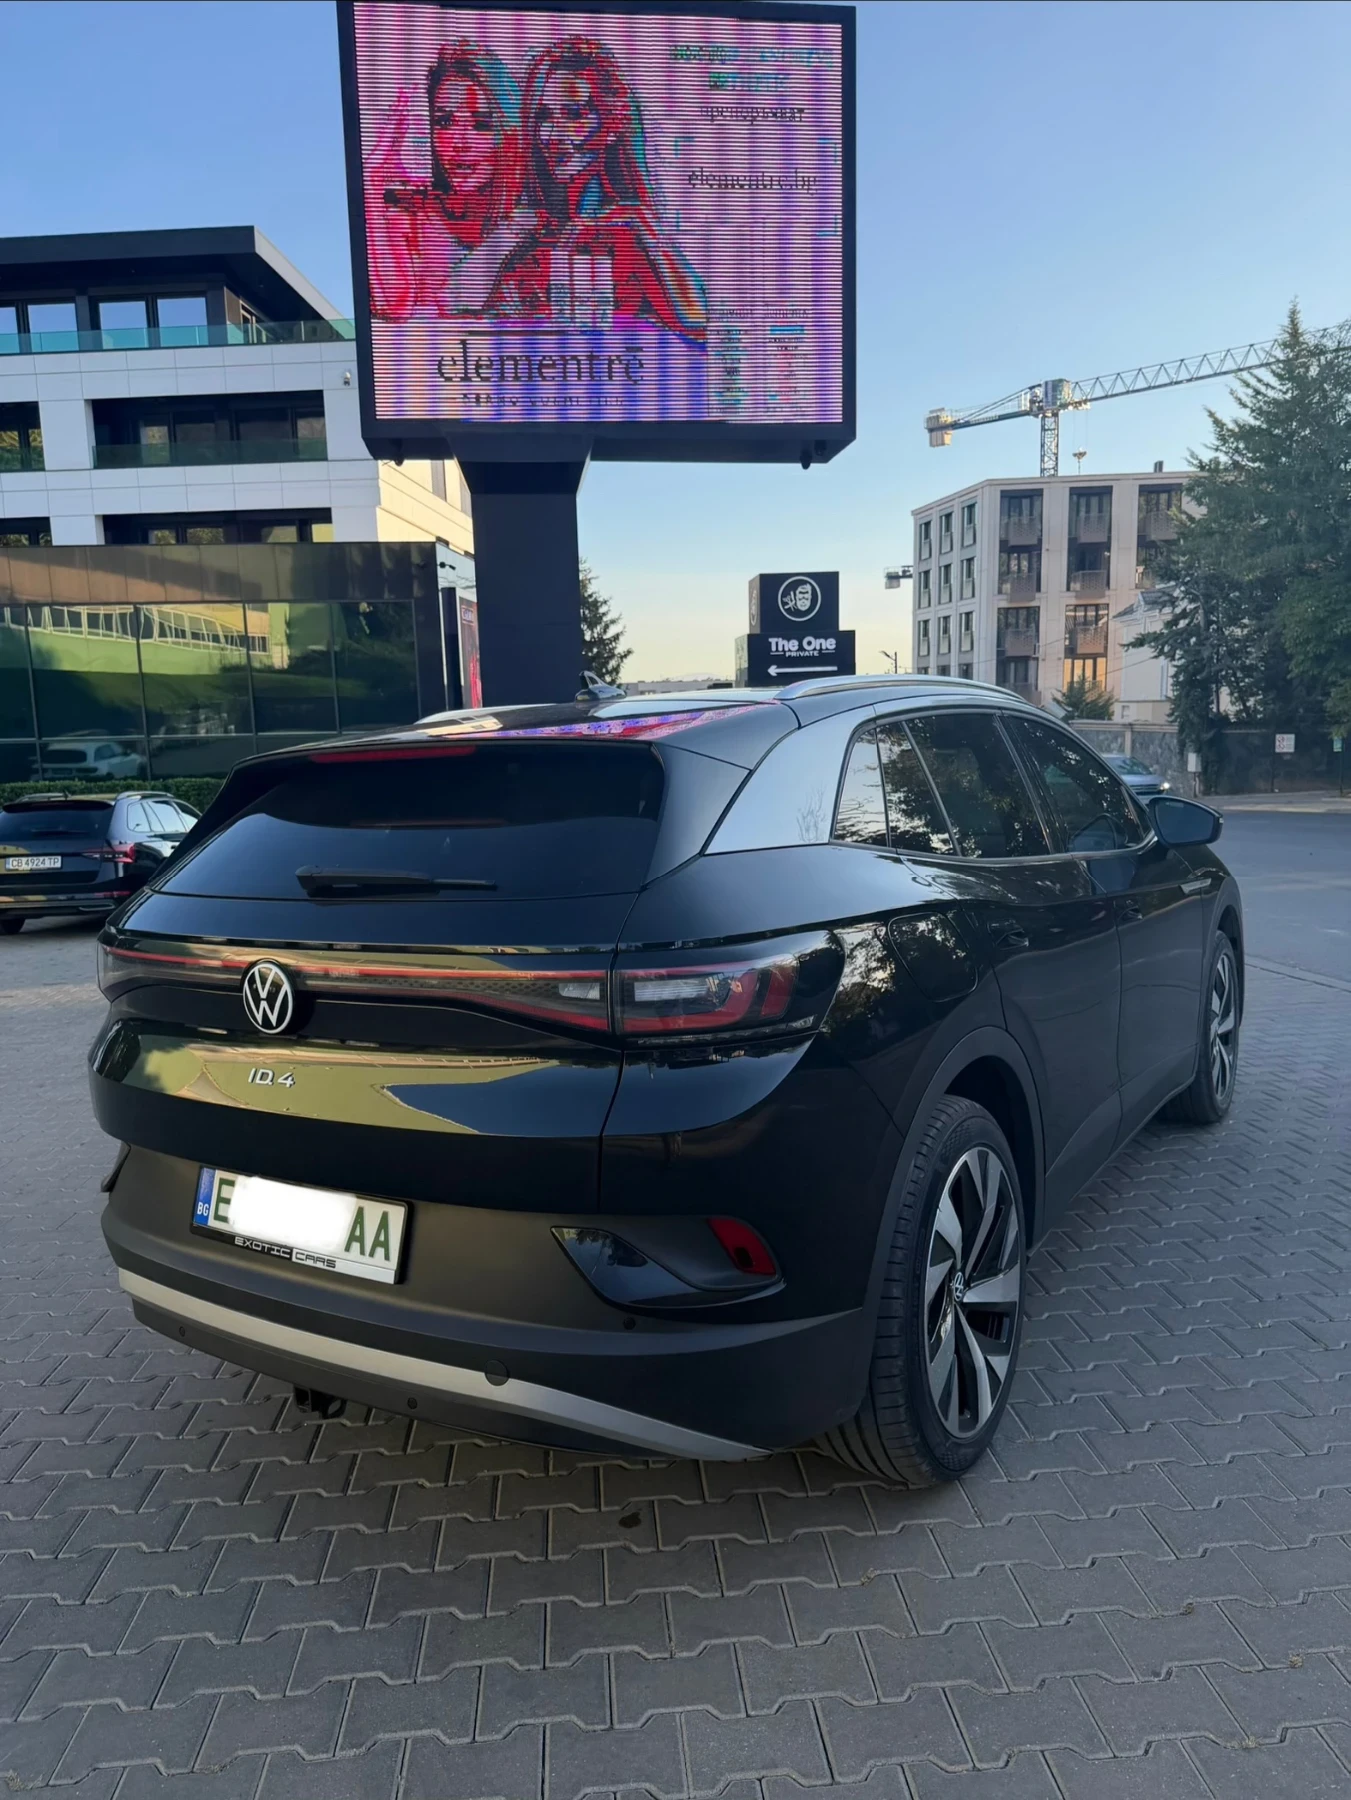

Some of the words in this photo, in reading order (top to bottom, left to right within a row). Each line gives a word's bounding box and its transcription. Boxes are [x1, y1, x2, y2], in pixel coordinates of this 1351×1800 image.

[768, 637, 799, 652] The
[802, 636, 837, 651] One
[11, 858, 23, 868] CB
[24, 858, 46, 867] 4924
[48, 857, 60, 866] TP
[196, 1201, 209, 1217] BG
[344, 1206, 391, 1261] AA
[234, 1236, 291, 1258] EXOTIC
[294, 1251, 337, 1268] CARS
